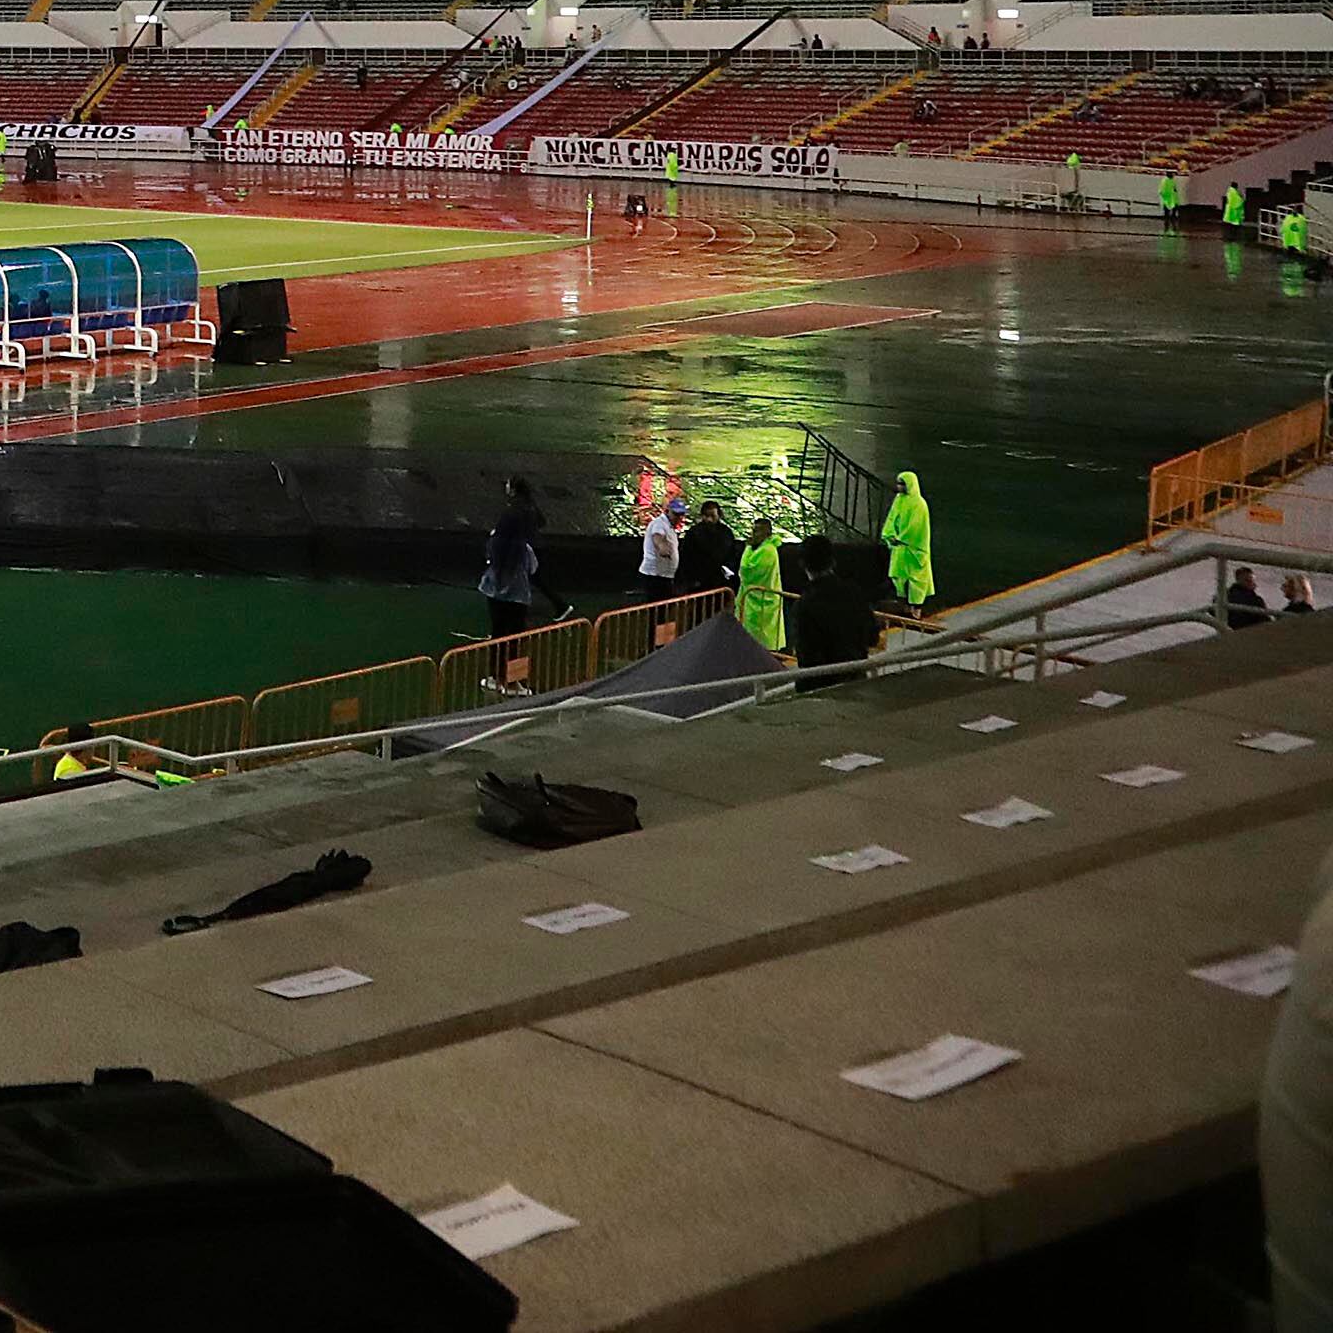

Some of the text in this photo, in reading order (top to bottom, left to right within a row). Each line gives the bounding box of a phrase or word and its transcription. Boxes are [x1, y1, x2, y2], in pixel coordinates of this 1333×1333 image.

[222, 129, 494, 150] TAN ETERNO SERA MI AMOR
[224, 147, 277, 163] COMO
[363, 149, 385, 165] TU
[392, 151, 502, 171] EXISTENCIA
[544, 139, 620, 164] NUNCA
[770, 147, 831, 175] SOLO
